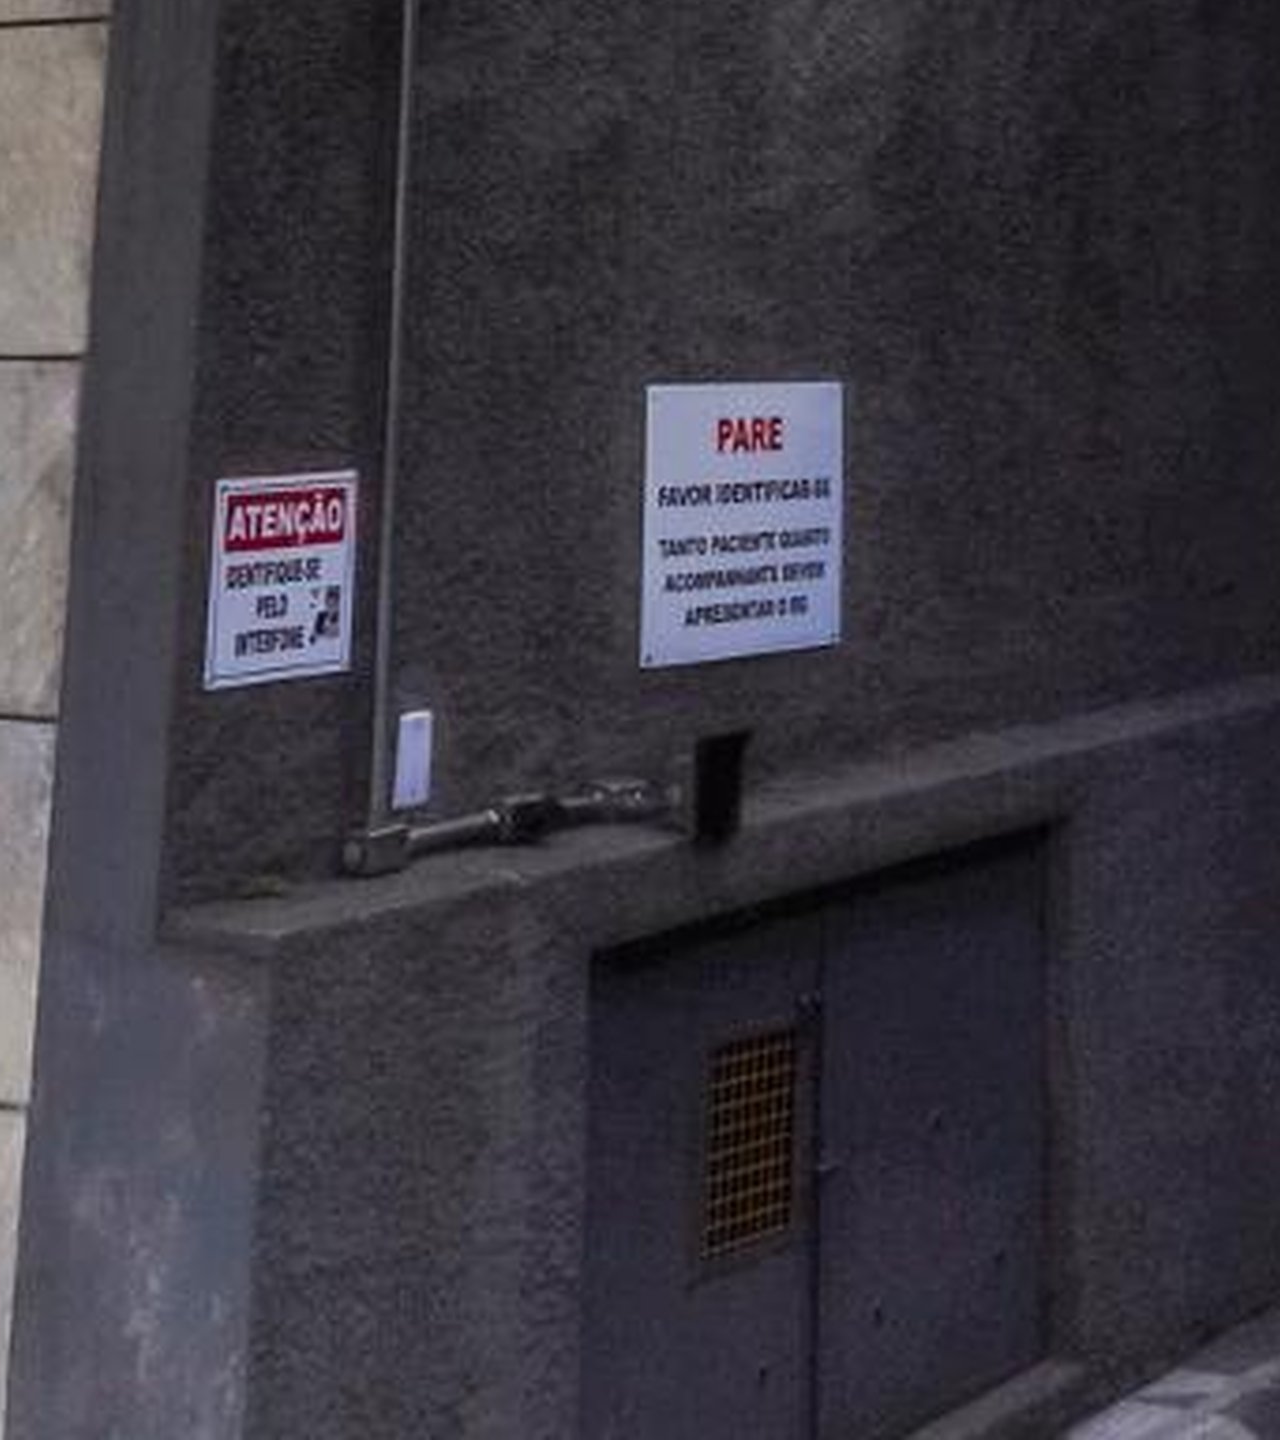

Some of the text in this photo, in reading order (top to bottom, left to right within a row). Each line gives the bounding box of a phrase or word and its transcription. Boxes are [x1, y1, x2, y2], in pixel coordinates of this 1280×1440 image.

[716, 417, 784, 452] PARE
[658, 483, 712, 508] FAVOR
[228, 493, 343, 545] ATENÇÃO
[658, 535, 708, 558] TANTO
[711, 530, 776, 555] PACIENTE
[256, 593, 289, 619] PELO
